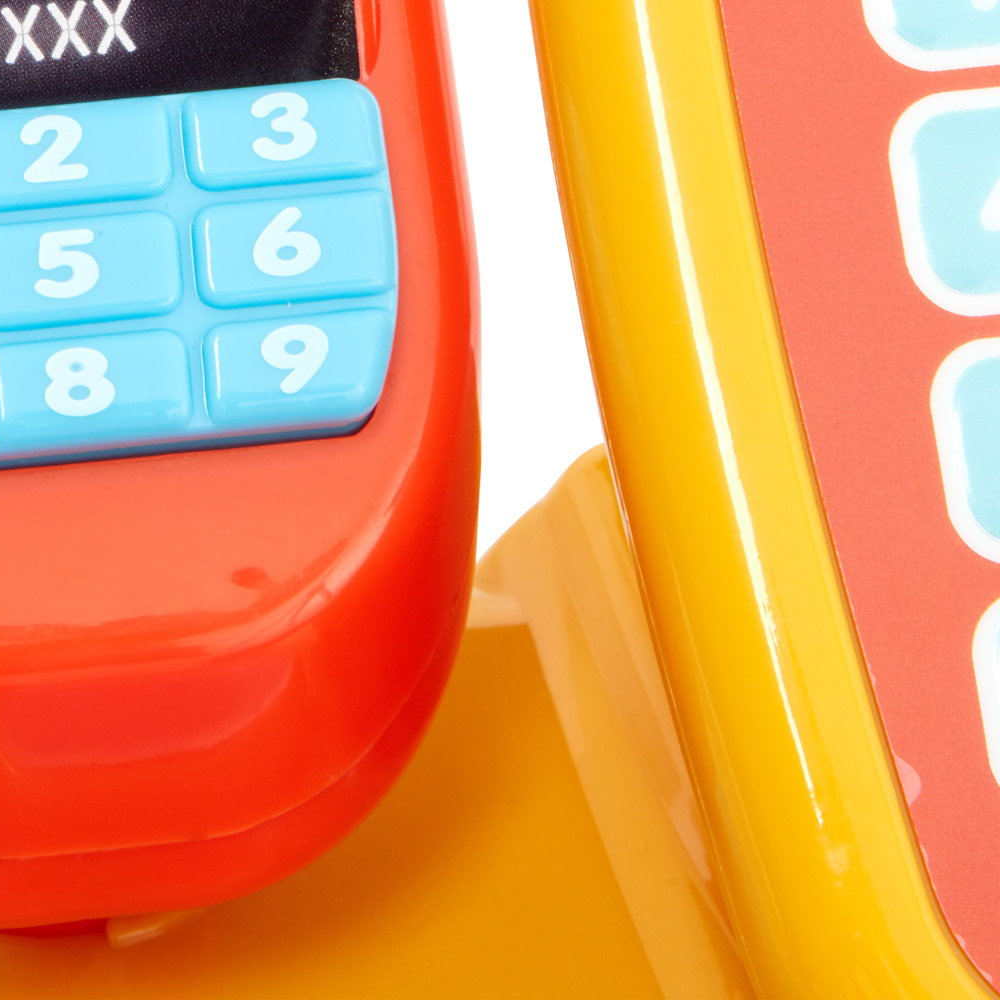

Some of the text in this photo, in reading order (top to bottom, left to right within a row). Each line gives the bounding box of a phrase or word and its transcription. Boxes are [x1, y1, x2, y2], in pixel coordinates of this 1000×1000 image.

[19, 114, 89, 183] 2
[250, 91, 319, 161] 3
[34, 228, 100, 299] 5
[252, 206, 322, 277] 6
[44, 347, 116, 416] 8
[260, 324, 330, 394] 9
